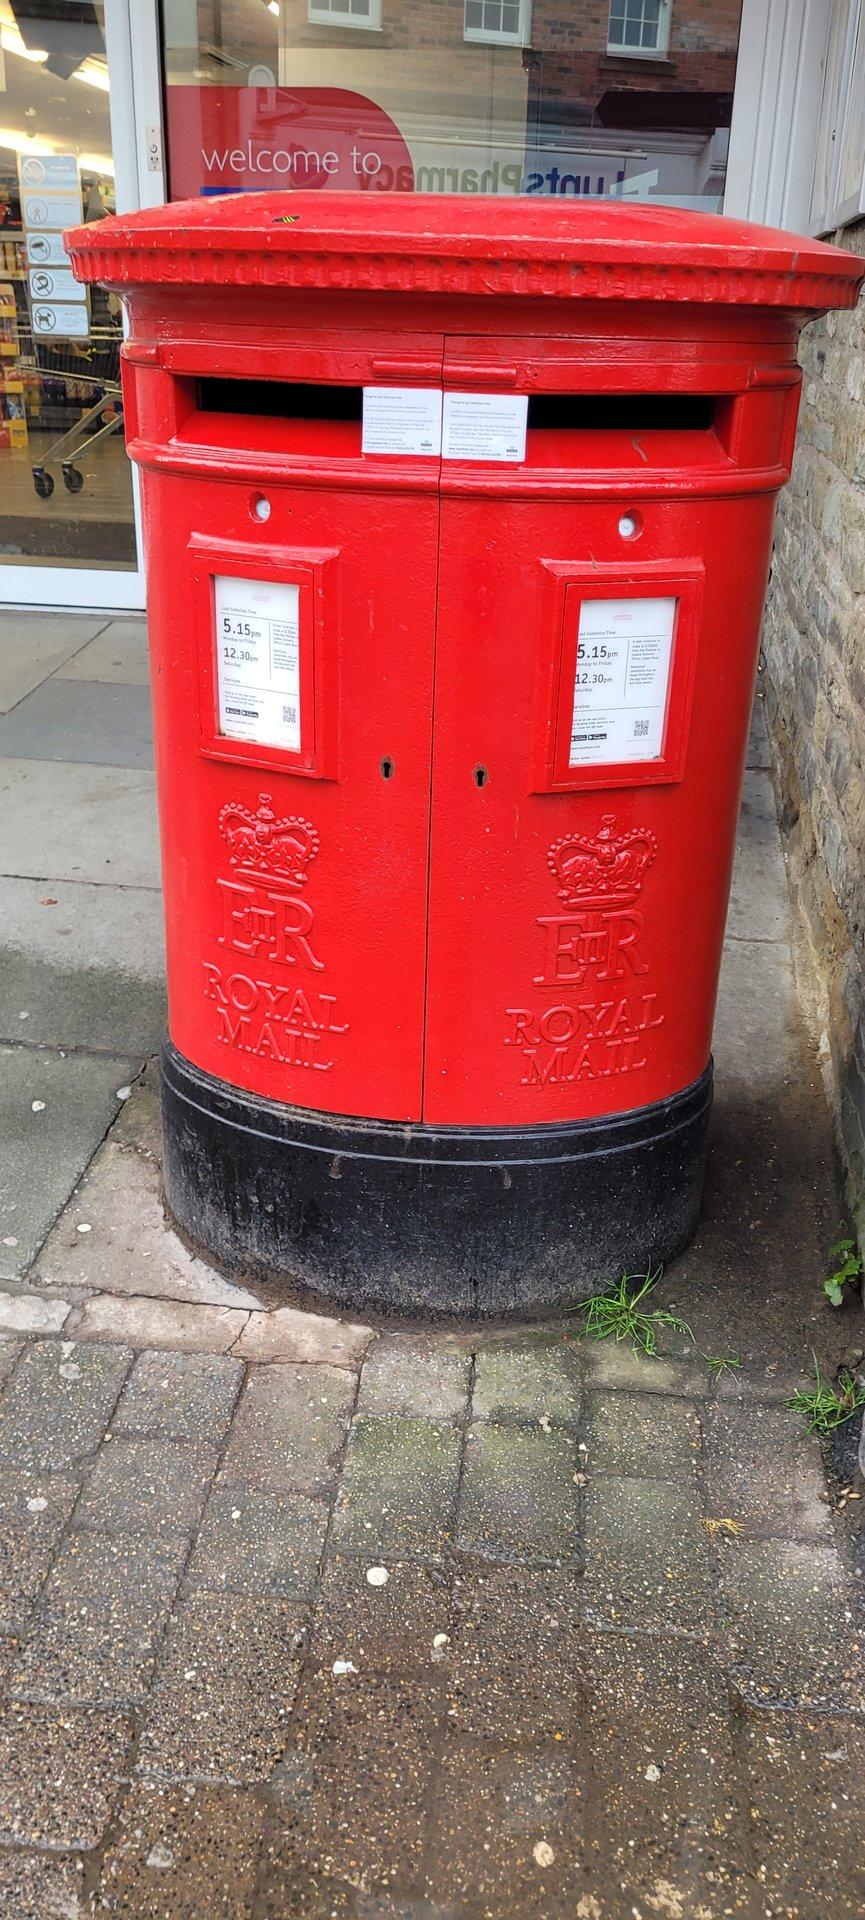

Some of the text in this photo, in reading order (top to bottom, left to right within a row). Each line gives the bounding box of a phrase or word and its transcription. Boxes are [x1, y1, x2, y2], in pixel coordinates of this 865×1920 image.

[201, 140, 382, 175] welcome to
[223, 617, 262, 638] 5.15pm
[223, 646, 259, 663] 12.30pm
[577, 643, 619, 659] 5.15pm
[575, 672, 613, 684] 12.30pm
[201, 960, 351, 1035] ROYAL
[504, 993, 665, 1046] ROYAL
[216, 1007, 335, 1072] MAIL
[520, 1036, 647, 1087] MAIL
